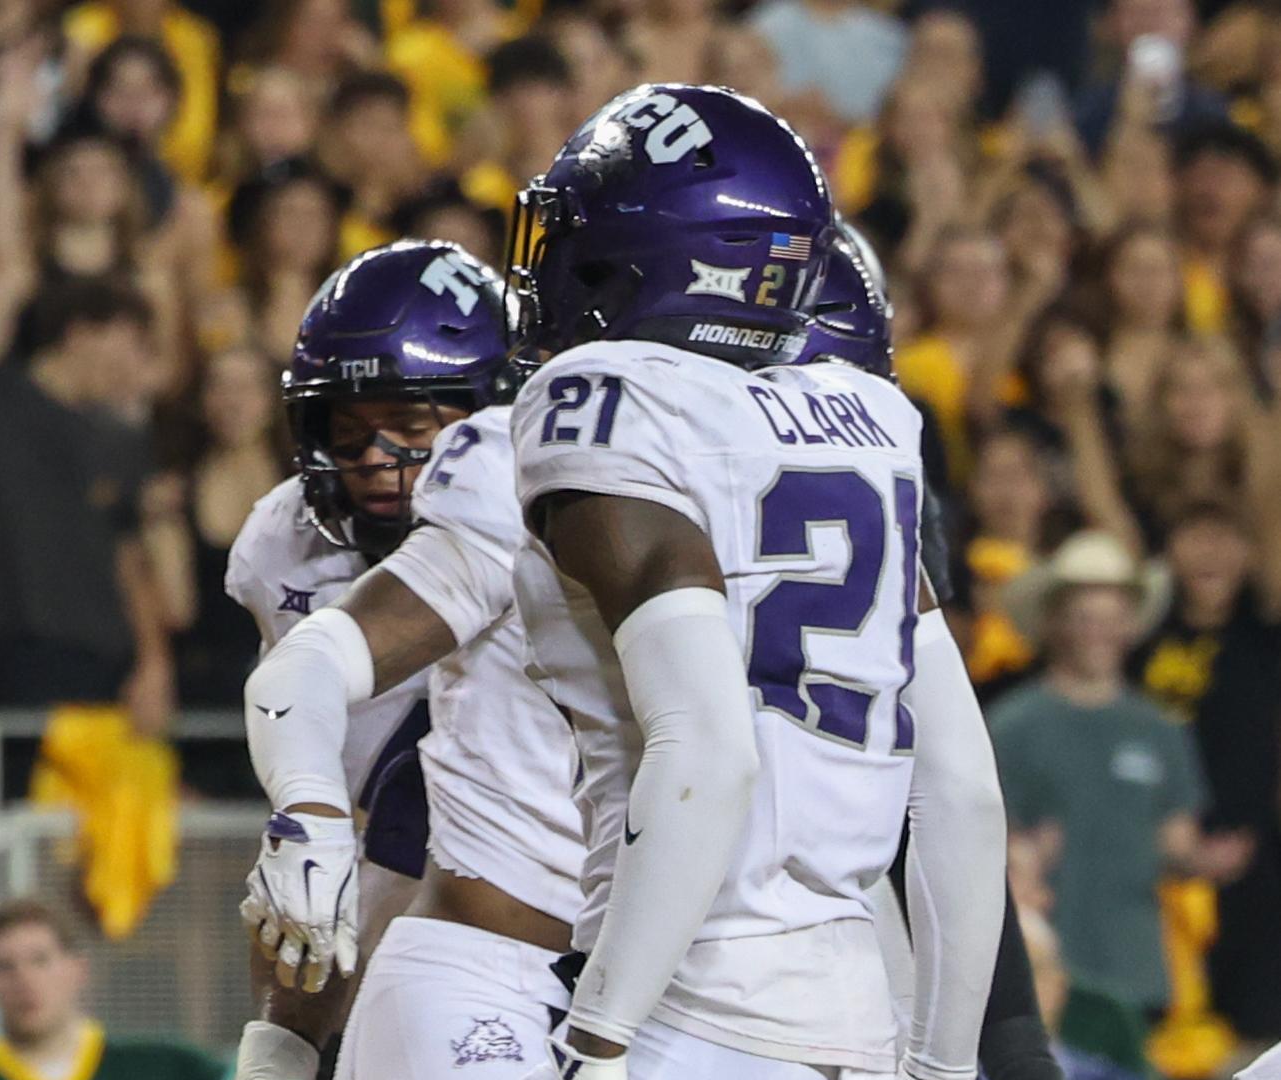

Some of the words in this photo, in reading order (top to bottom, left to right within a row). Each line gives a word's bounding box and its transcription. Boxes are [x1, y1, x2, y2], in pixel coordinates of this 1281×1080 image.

[688, 323, 776, 349] HORNED
[340, 358, 379, 379] TCU
[540, 375, 623, 448] 21
[746, 384, 898, 448] CLARK
[746, 465, 920, 757] 21
